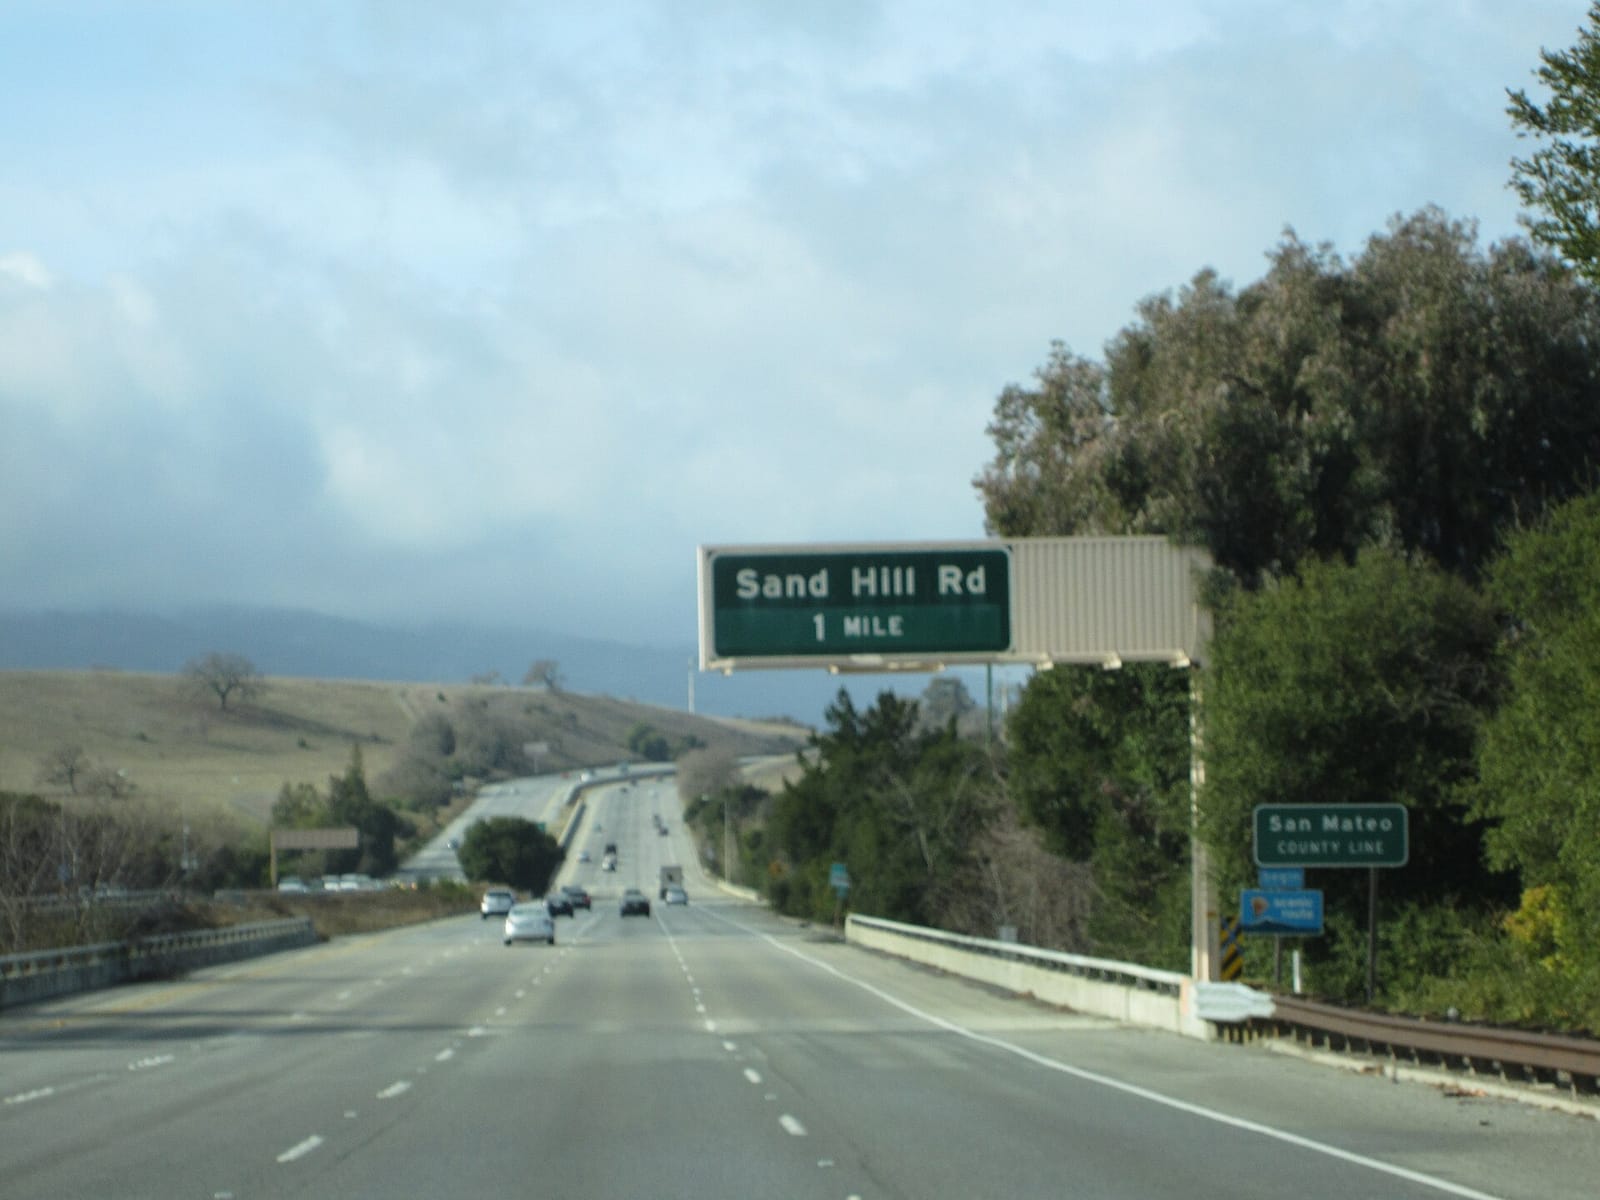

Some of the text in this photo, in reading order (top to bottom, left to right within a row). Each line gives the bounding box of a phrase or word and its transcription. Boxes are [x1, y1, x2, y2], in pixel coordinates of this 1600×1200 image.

[736, 564, 987, 599] Sand Hill Rd
[813, 613, 904, 642] 1 MILE
[1269, 814, 1393, 832] San Mateo
[1277, 840, 1385, 855] COUNTY LINE
